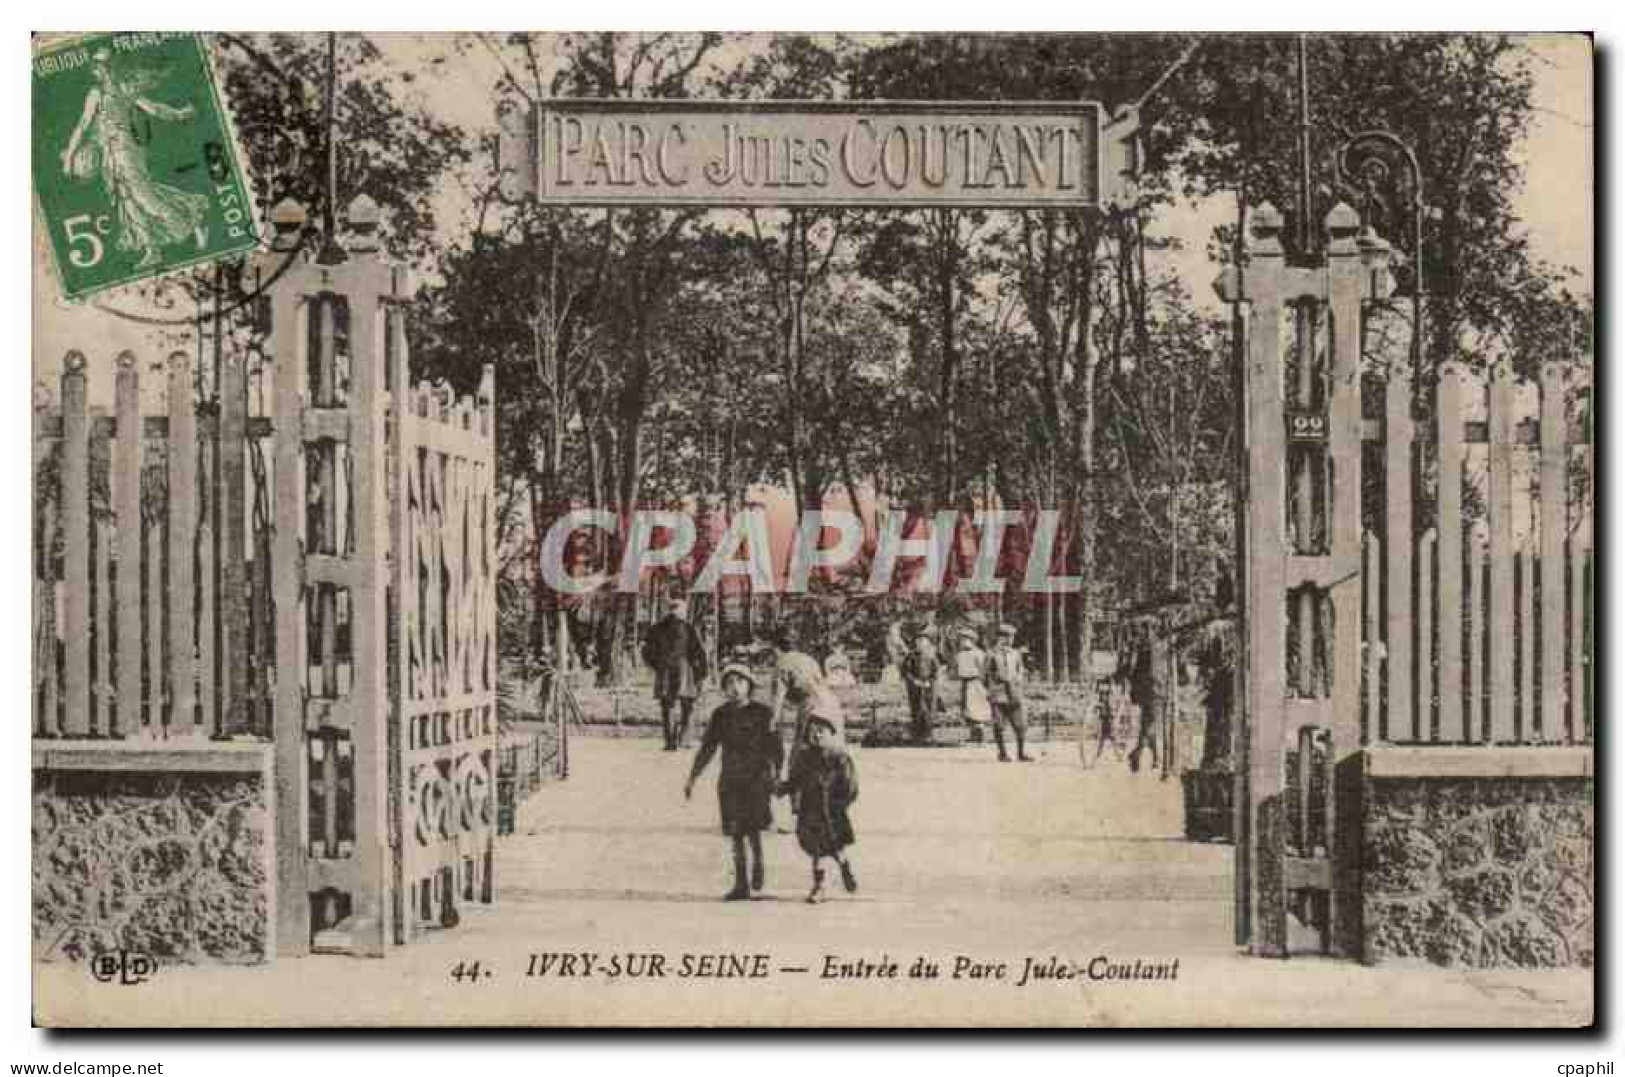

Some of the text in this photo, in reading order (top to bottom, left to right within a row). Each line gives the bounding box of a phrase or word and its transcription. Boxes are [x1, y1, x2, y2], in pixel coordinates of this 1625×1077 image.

[554, 116, 690, 187] PARC
[839, 117, 1082, 190] COUTANT
[820, 955, 898, 979] Entrée
[908, 956, 939, 979] du
[952, 956, 1007, 980] Parc
